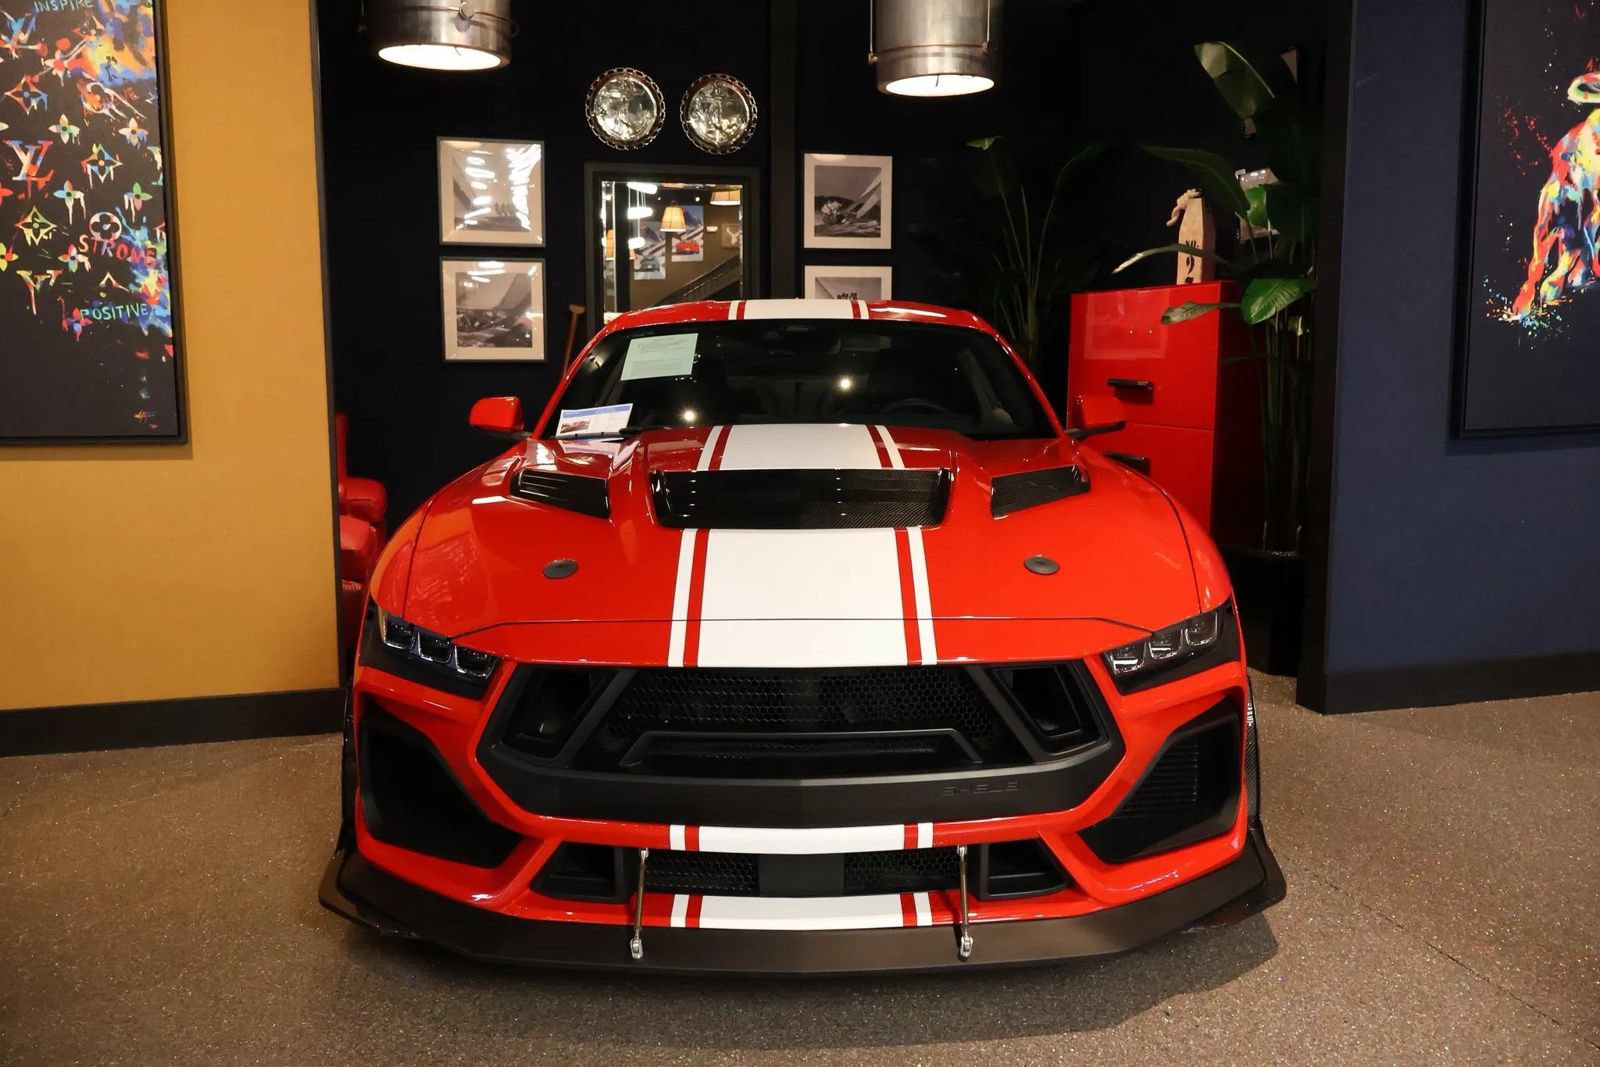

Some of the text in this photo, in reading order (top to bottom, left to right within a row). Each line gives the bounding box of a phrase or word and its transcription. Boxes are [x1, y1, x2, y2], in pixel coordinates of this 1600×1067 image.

[34, 0, 94, 12] INSPIRE
[80, 302, 149, 321] POSITIVE
[941, 780, 1030, 797] SHELB
